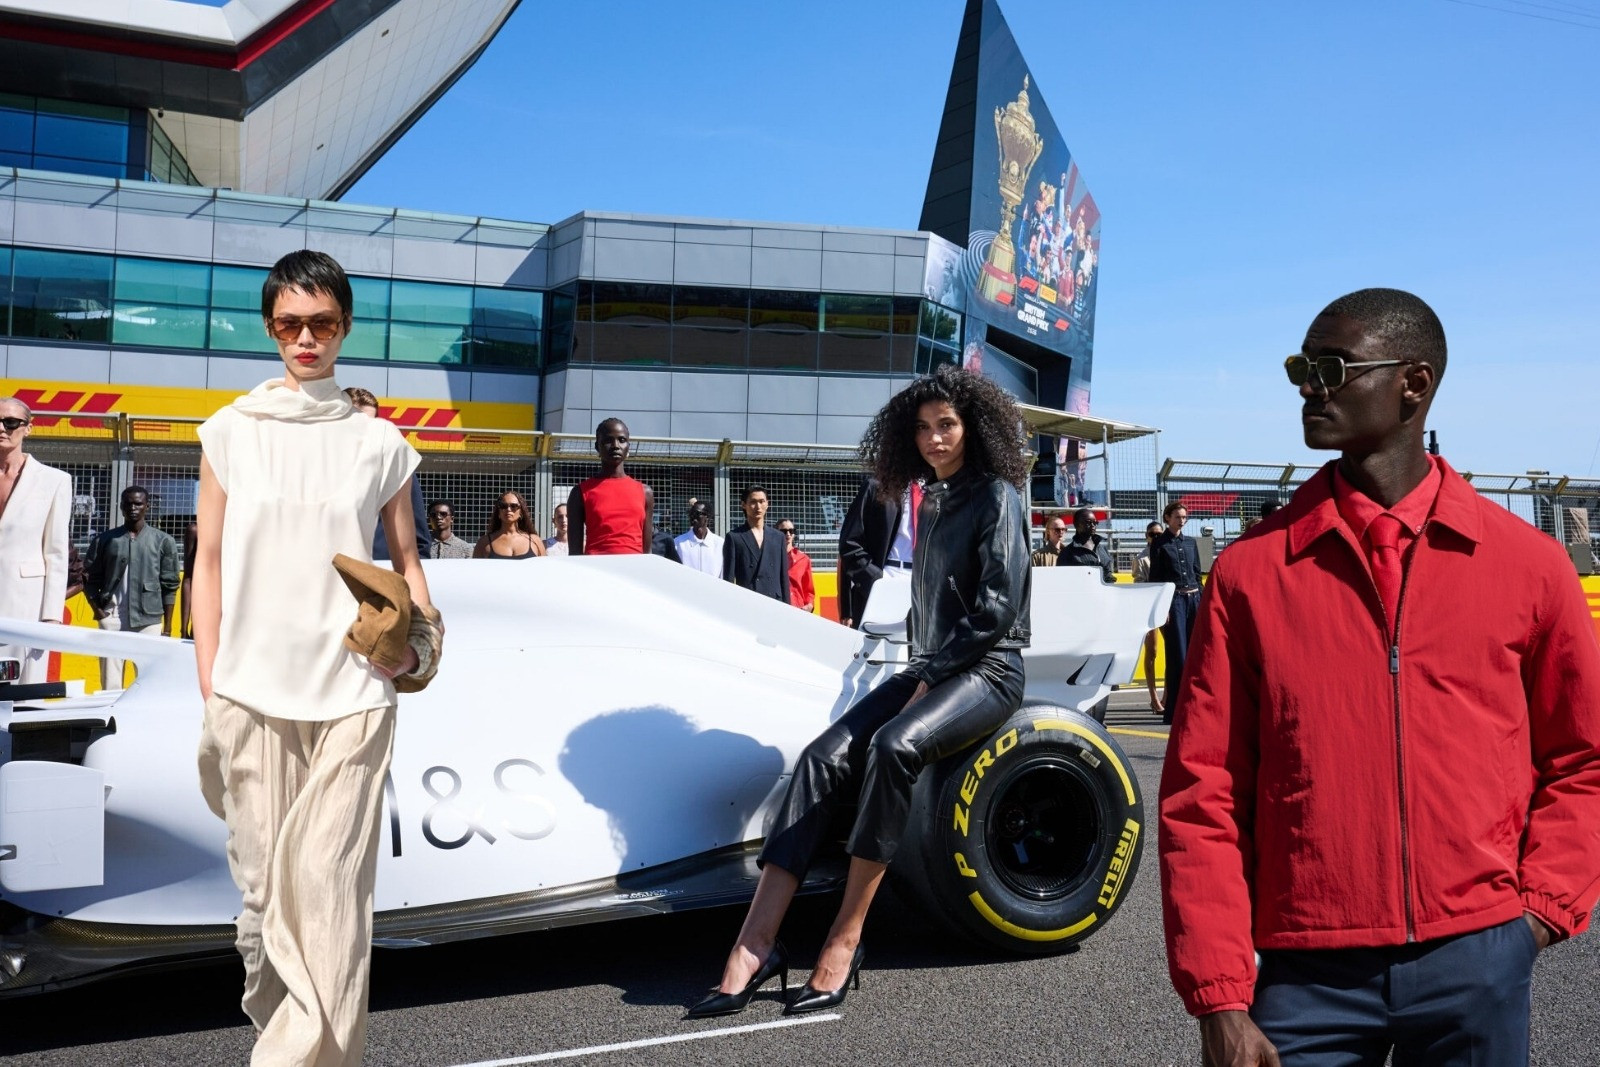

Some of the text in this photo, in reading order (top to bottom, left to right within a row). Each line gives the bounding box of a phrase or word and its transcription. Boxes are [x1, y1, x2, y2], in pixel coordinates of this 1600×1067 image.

[1017, 310, 1037, 326] GRAND
[1036, 318, 1049, 332] PRIX
[12, 389, 123, 429] HL
[378, 406, 466, 442] HL
[953, 728, 1018, 878] P ZERO
[1097, 818, 1140, 909] PIRELLI
